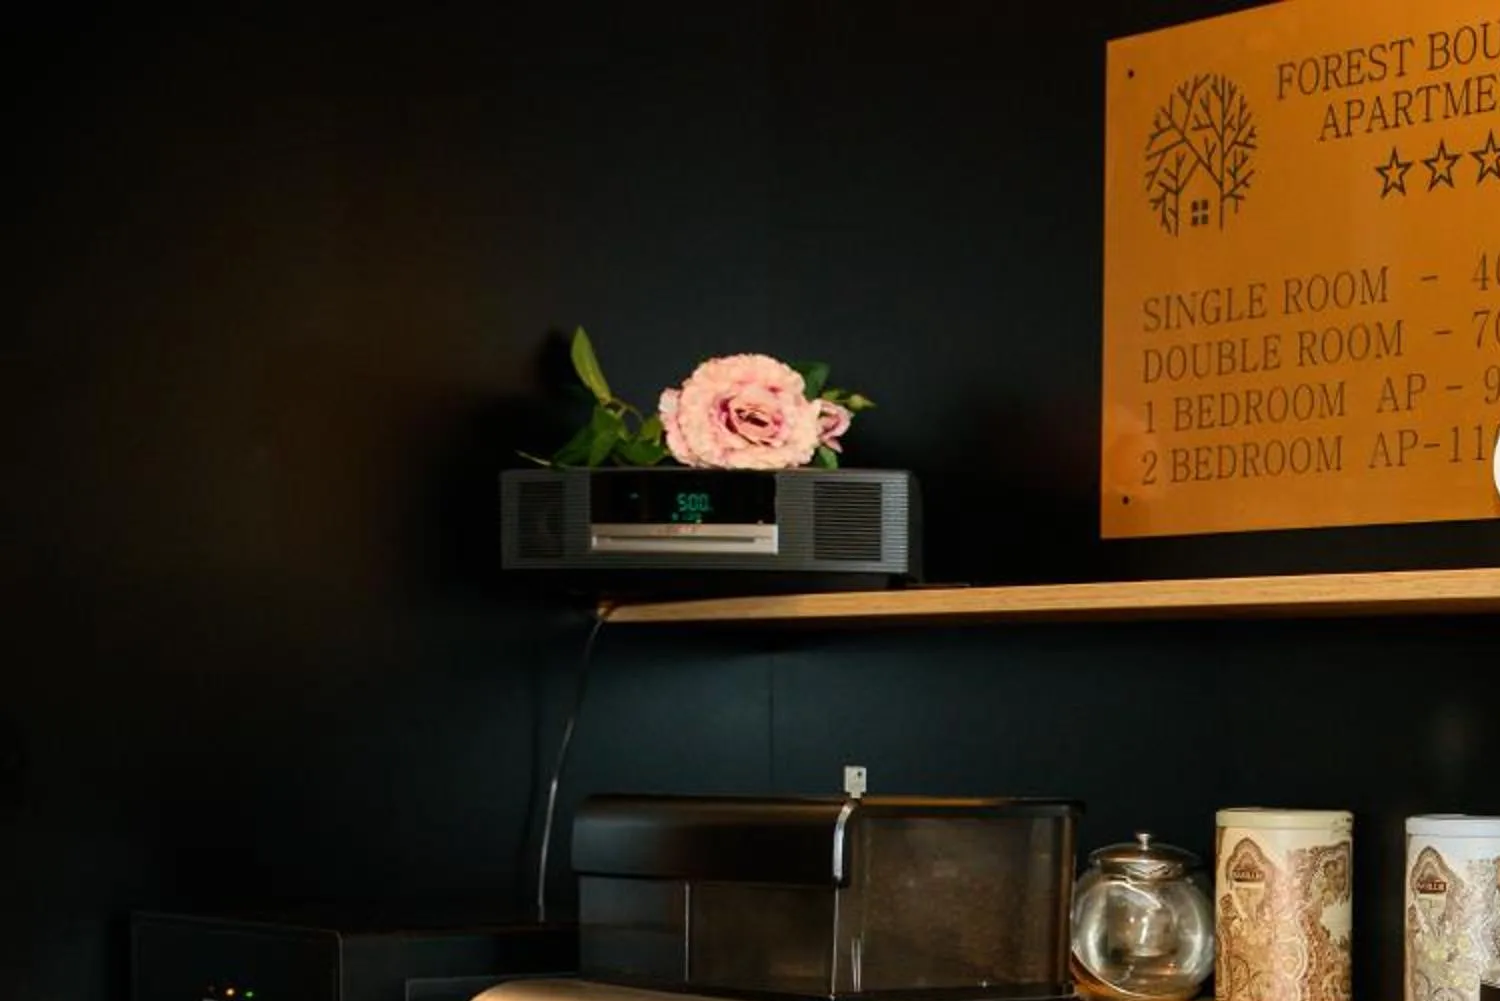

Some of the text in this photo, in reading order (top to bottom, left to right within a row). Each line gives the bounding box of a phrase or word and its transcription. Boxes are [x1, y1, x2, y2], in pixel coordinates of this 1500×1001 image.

[1276, 38, 1415, 101] FOREST
[1142, 282, 1267, 333] SINGLE
[1282, 266, 1390, 315] ROOM
[1142, 334, 1283, 385] DOUBLE
[1296, 321, 1405, 369] ROOM
[1144, 401, 1157, 435] 1
[1173, 381, 1346, 433] BEDROOM
[1375, 373, 1427, 415] AP
[1141, 450, 1158, 486] 2
[1170, 435, 1344, 485] BEDROOM
